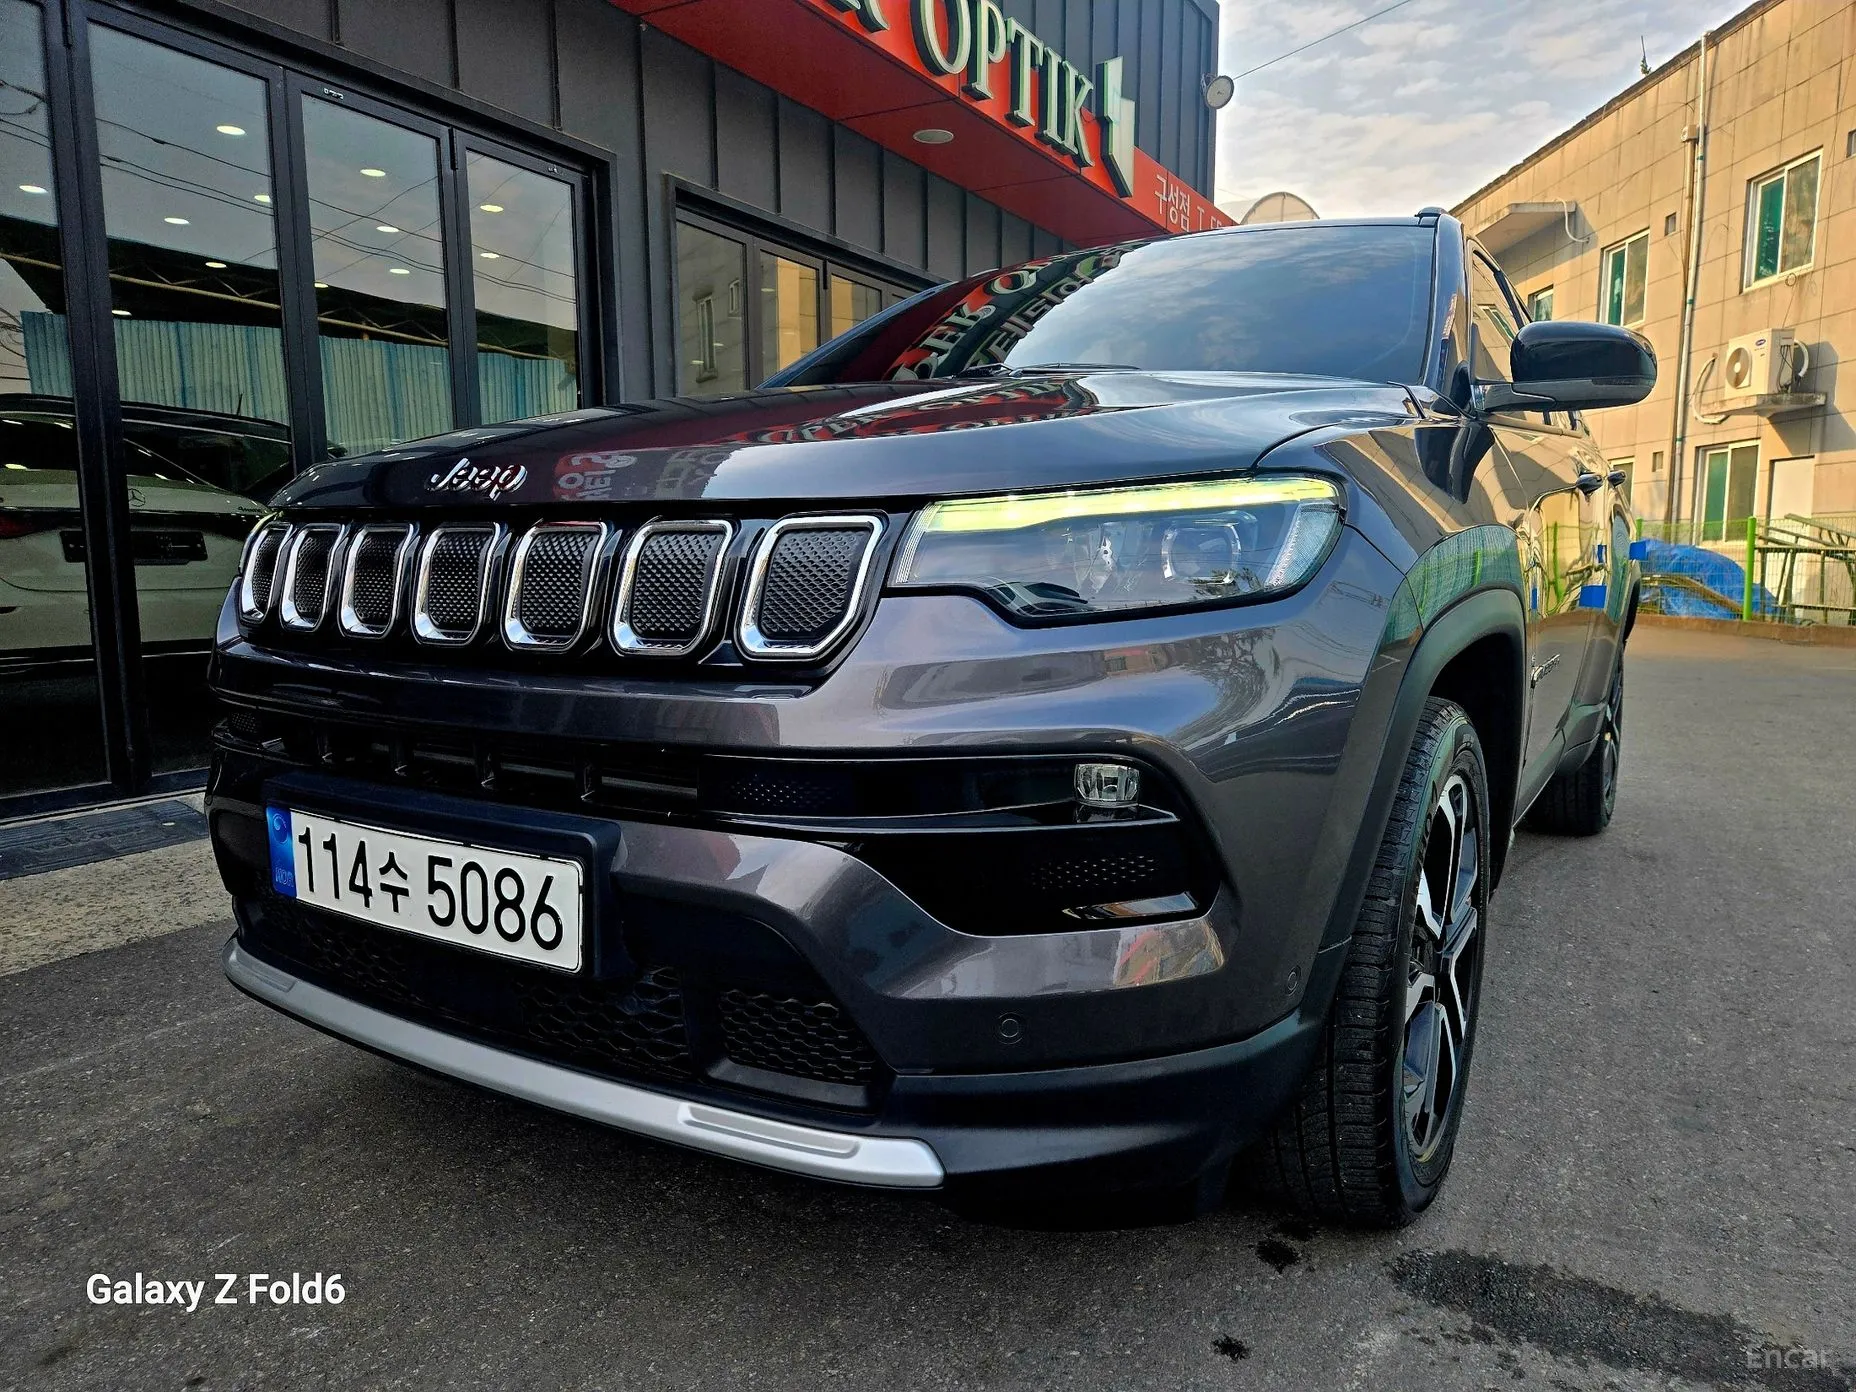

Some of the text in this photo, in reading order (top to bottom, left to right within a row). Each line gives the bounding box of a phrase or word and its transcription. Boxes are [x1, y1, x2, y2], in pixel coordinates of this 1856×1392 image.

[912, 0, 1095, 167] OPTIK
[1154, 174, 1190, 232] 구성점
[425, 457, 528, 500] Jeep
[427, 855, 563, 950] 5086
